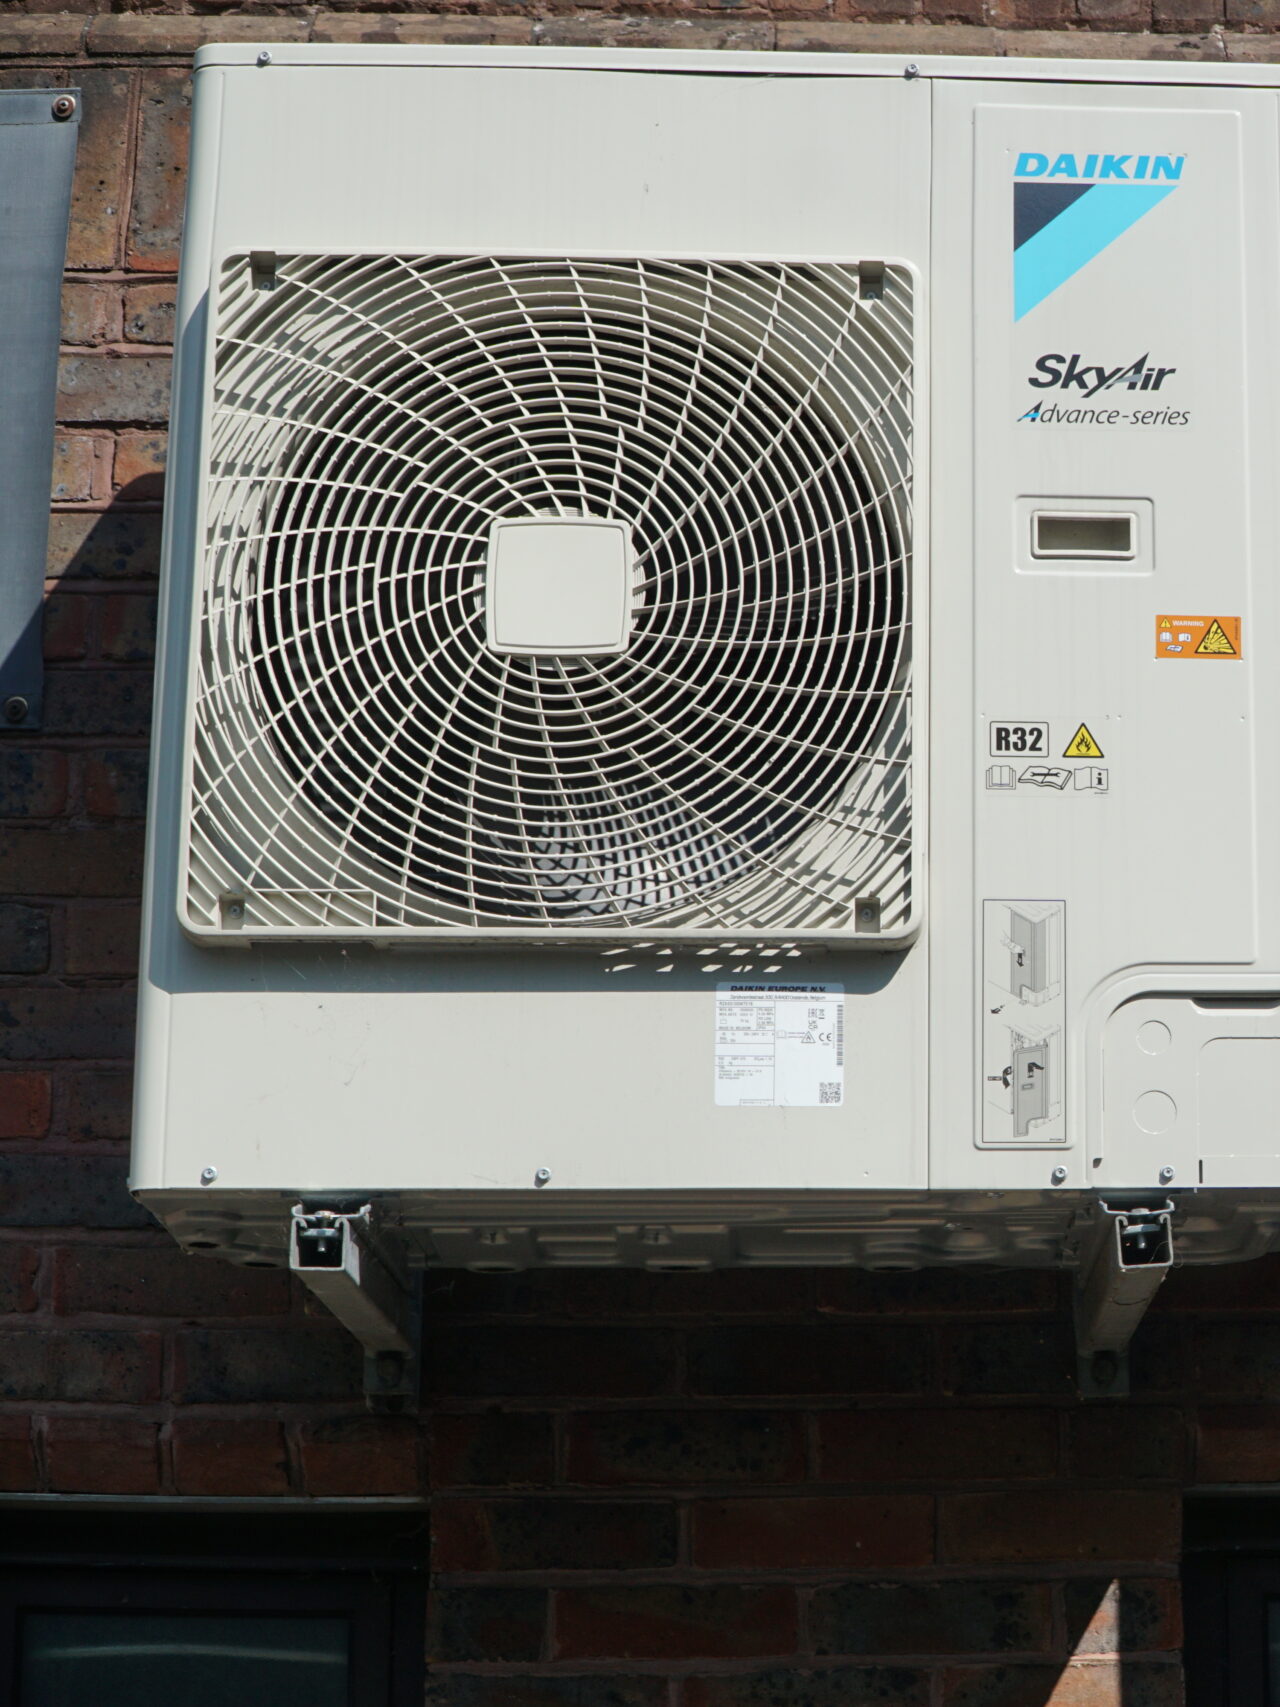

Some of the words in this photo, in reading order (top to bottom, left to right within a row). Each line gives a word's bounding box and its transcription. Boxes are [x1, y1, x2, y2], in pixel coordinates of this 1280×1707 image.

[1014, 152, 1186, 180] DAIKIN
[1028, 352, 1177, 398] SkyAir
[1016, 400, 1190, 425] Advance-series
[996, 727, 1043, 751] R32
